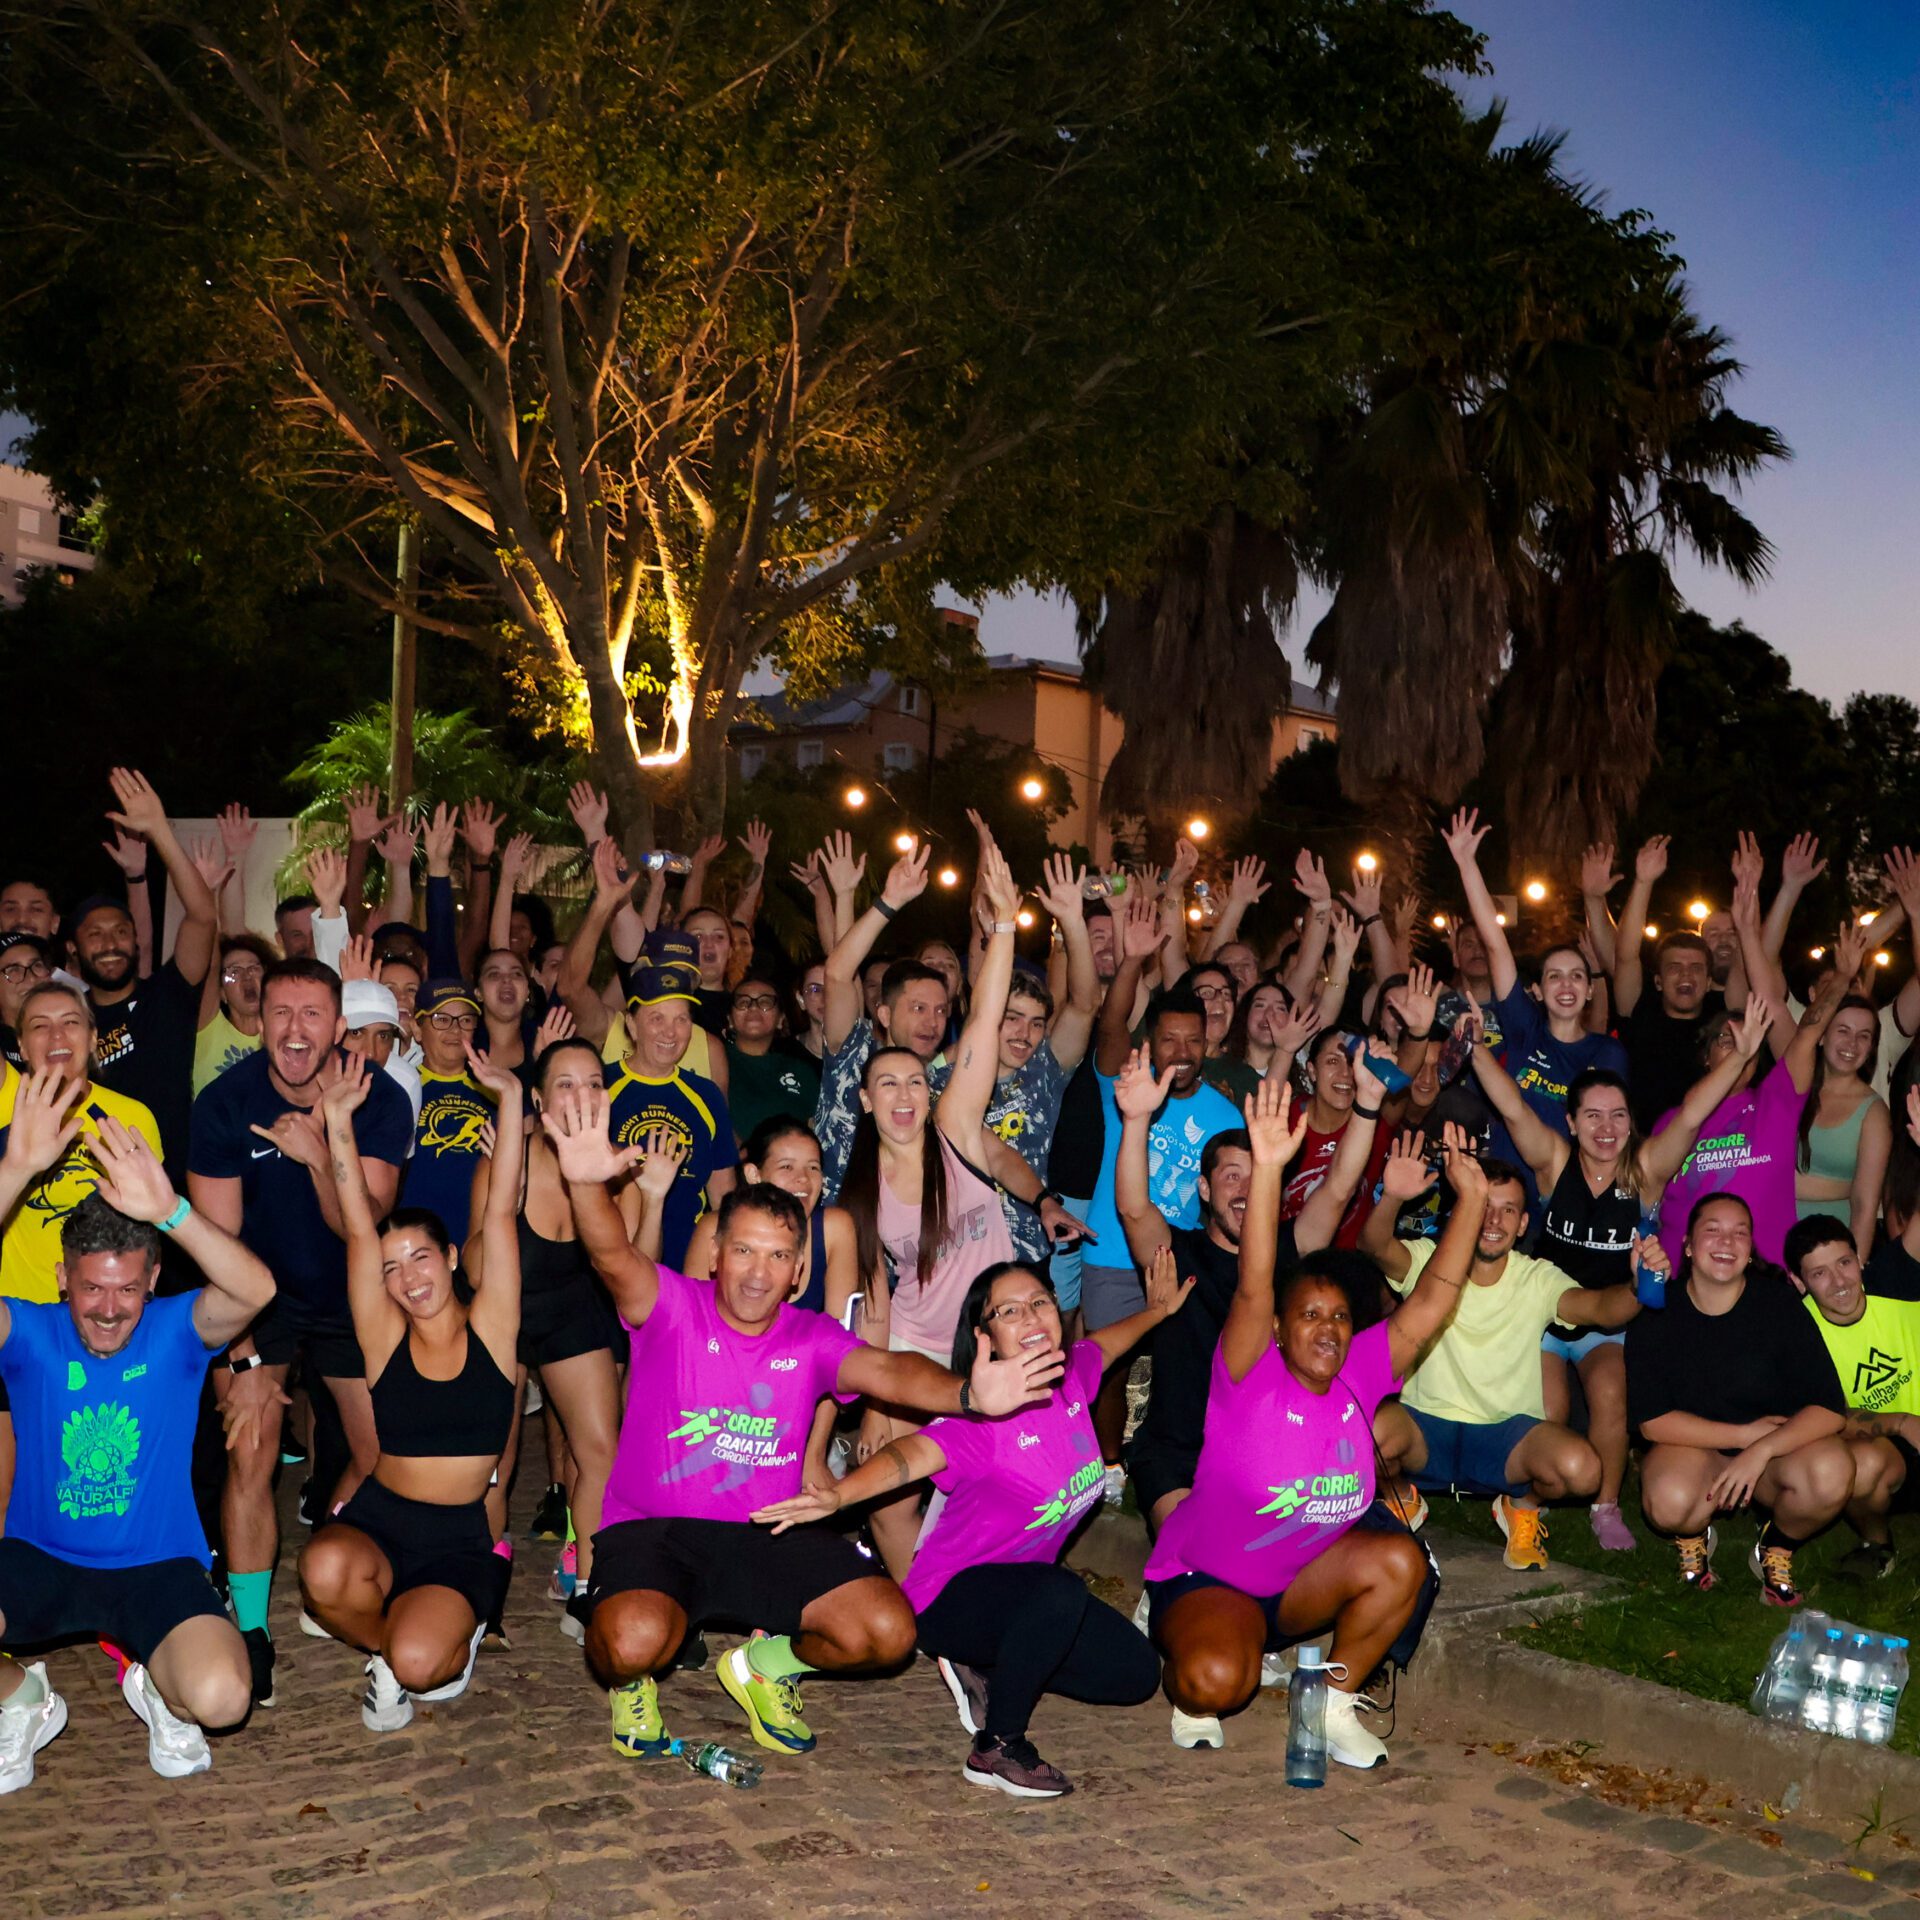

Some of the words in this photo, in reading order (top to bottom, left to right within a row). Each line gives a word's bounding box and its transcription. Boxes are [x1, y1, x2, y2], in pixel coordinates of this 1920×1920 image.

[418, 1100, 437, 1127] NIGHT
[438, 1099, 488, 1115] RUNNERS
[617, 1114, 640, 1143] NIGHT
[641, 1110, 691, 1132] RUNNERS
[1696, 1133, 1746, 1152] CORRE
[1696, 1145, 1752, 1164] GRAVATAÍ
[1697, 1162, 1727, 1173] CORRIDA
[1727, 1160, 1733, 1169] E
[1732, 1154, 1772, 1168] CAMINHADA
[82, 1502, 114, 1516] 2025
[1305, 1488, 1364, 1514] GRAVATAÍ
[1301, 1513, 1336, 1524] CORRIDA
